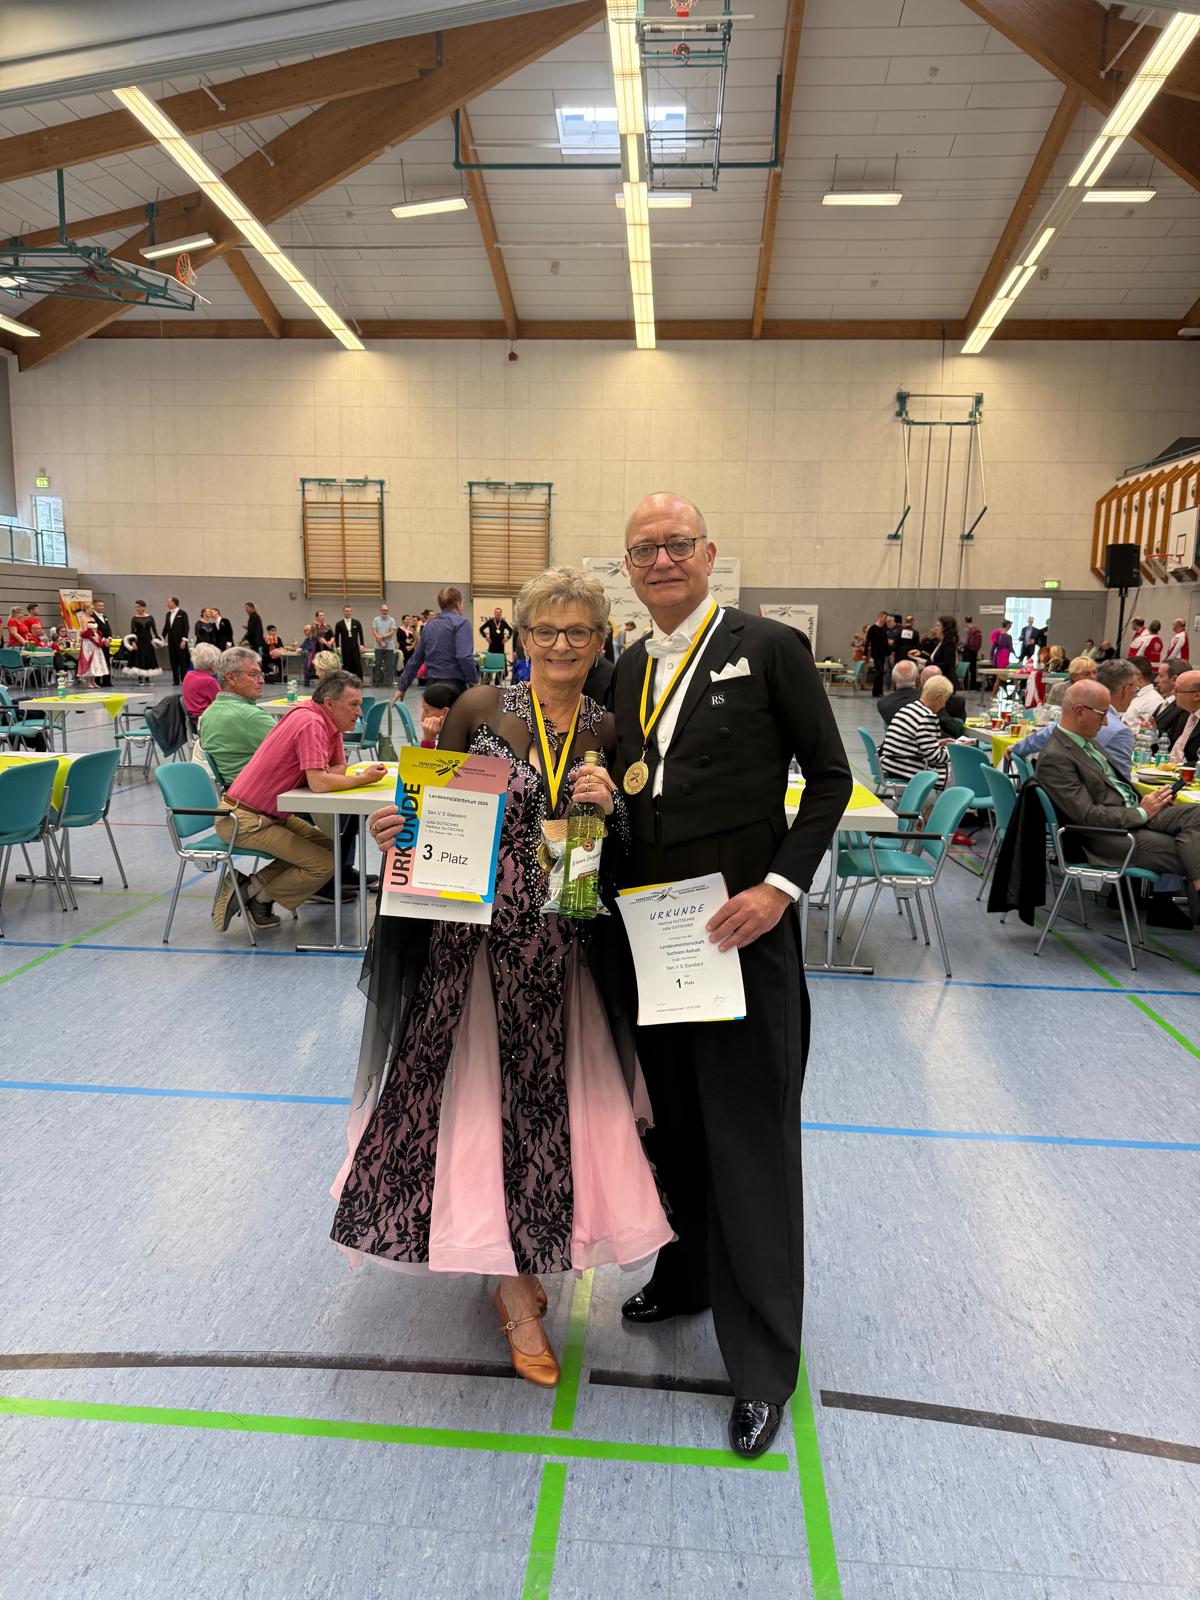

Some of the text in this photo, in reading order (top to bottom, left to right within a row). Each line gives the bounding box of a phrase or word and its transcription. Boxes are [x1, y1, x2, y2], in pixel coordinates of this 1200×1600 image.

[711, 694, 725, 706] RS
[391, 783, 421, 886] URKUNDE
[422, 843, 433, 860] 3
[650, 903, 705, 920] URKUNDE
[676, 978, 682, 989] 1
